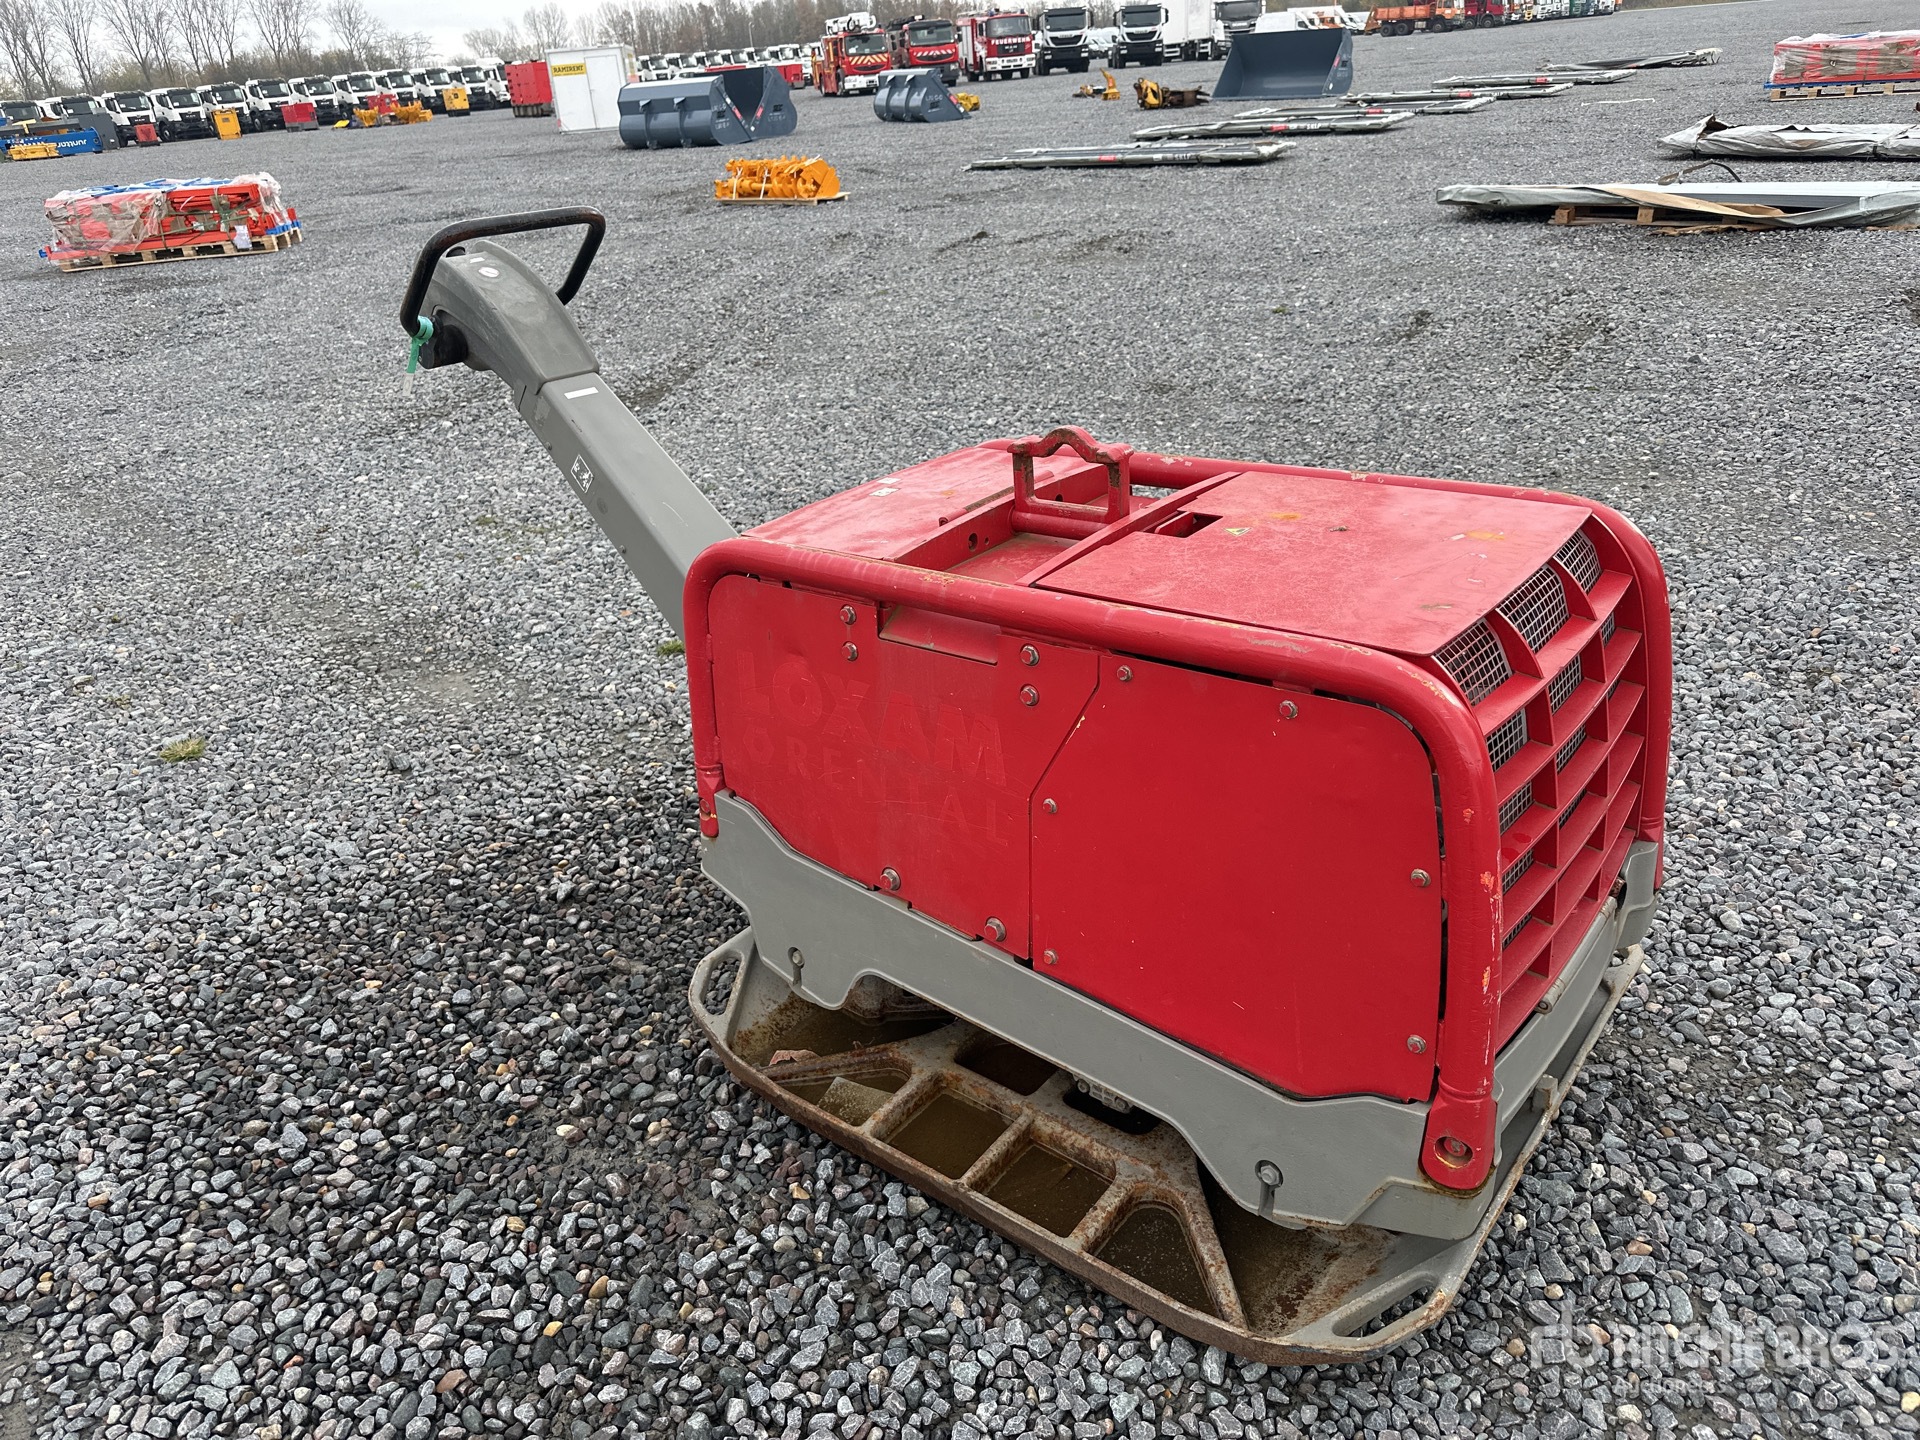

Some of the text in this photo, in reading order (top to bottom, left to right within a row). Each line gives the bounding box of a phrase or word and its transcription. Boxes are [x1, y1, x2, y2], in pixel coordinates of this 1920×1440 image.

[553, 65, 583, 73] RAMIRENT
[737, 650, 1006, 787] LOXAM
[786, 736, 1008, 848] RENTAL
